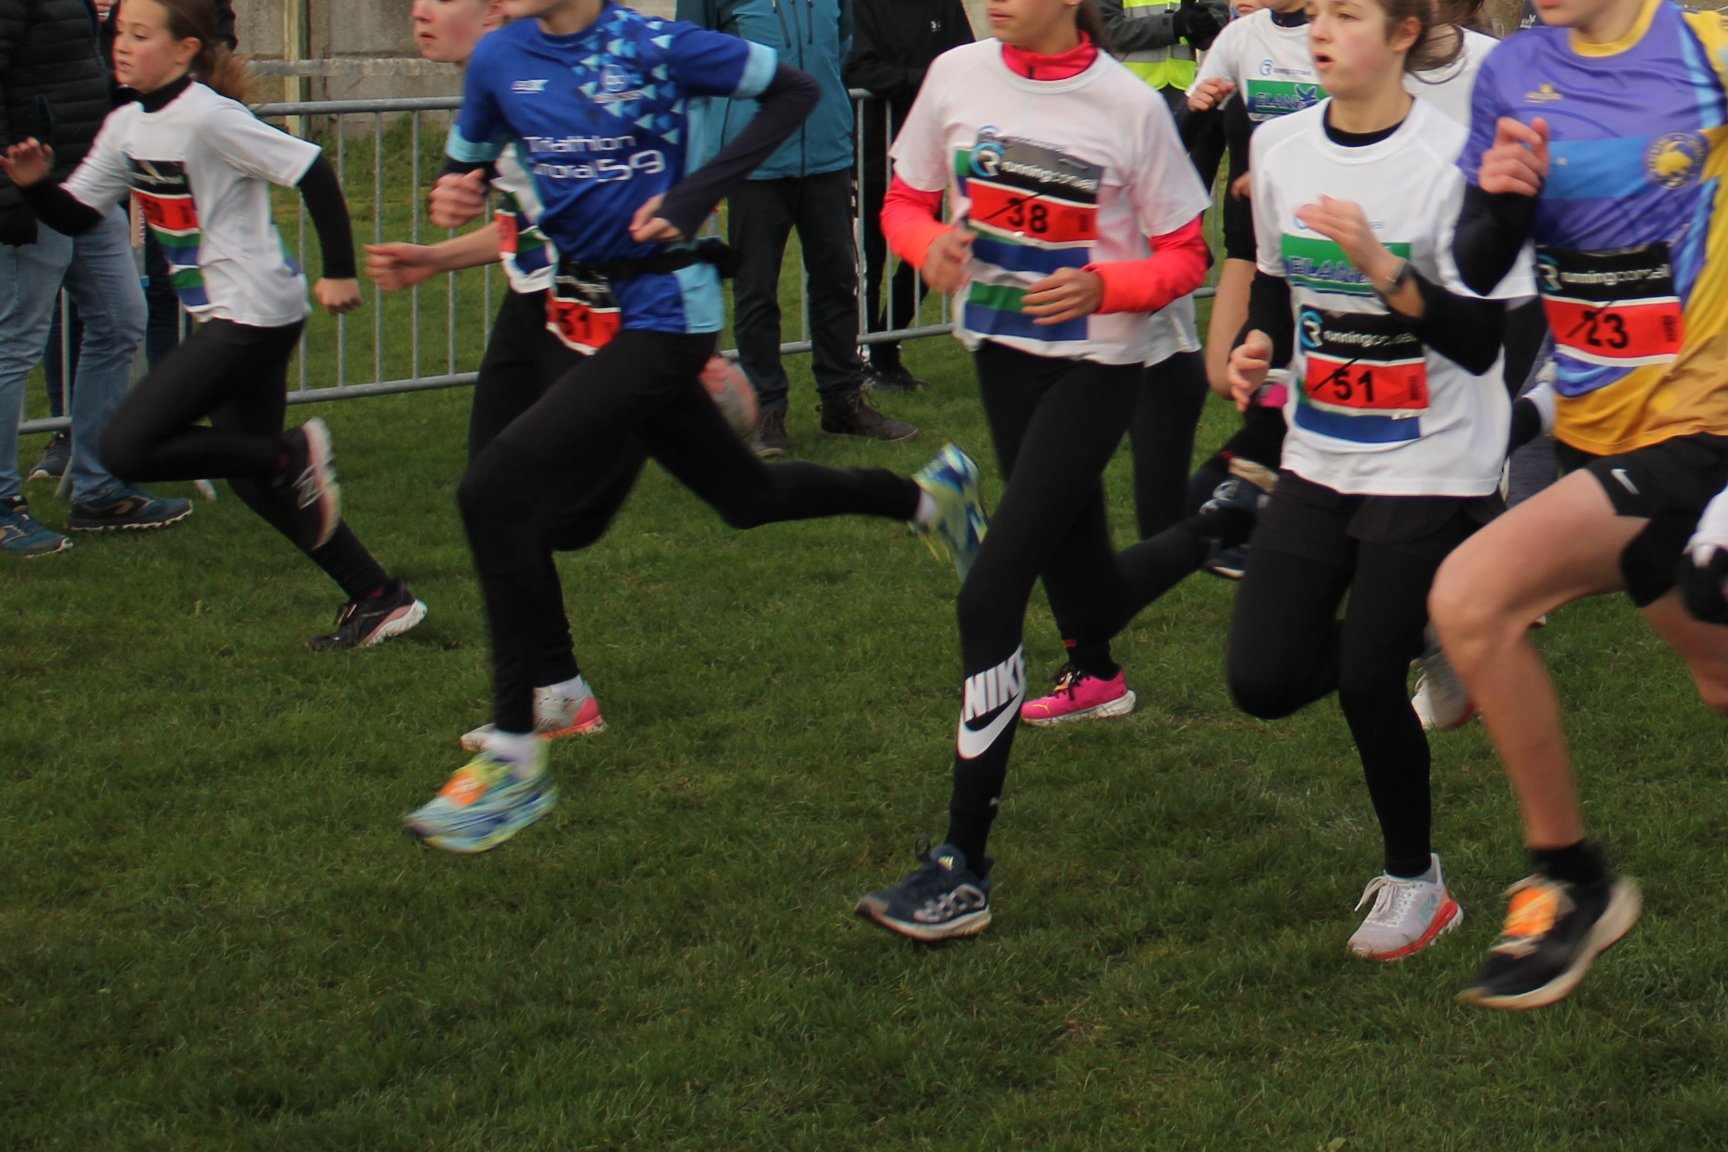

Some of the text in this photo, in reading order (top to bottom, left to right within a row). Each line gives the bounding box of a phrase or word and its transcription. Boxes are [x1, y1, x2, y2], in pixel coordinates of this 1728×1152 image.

[1007, 197, 1048, 234] 38
[1584, 309, 1629, 350] 23
[1333, 368, 1375, 403] 51
